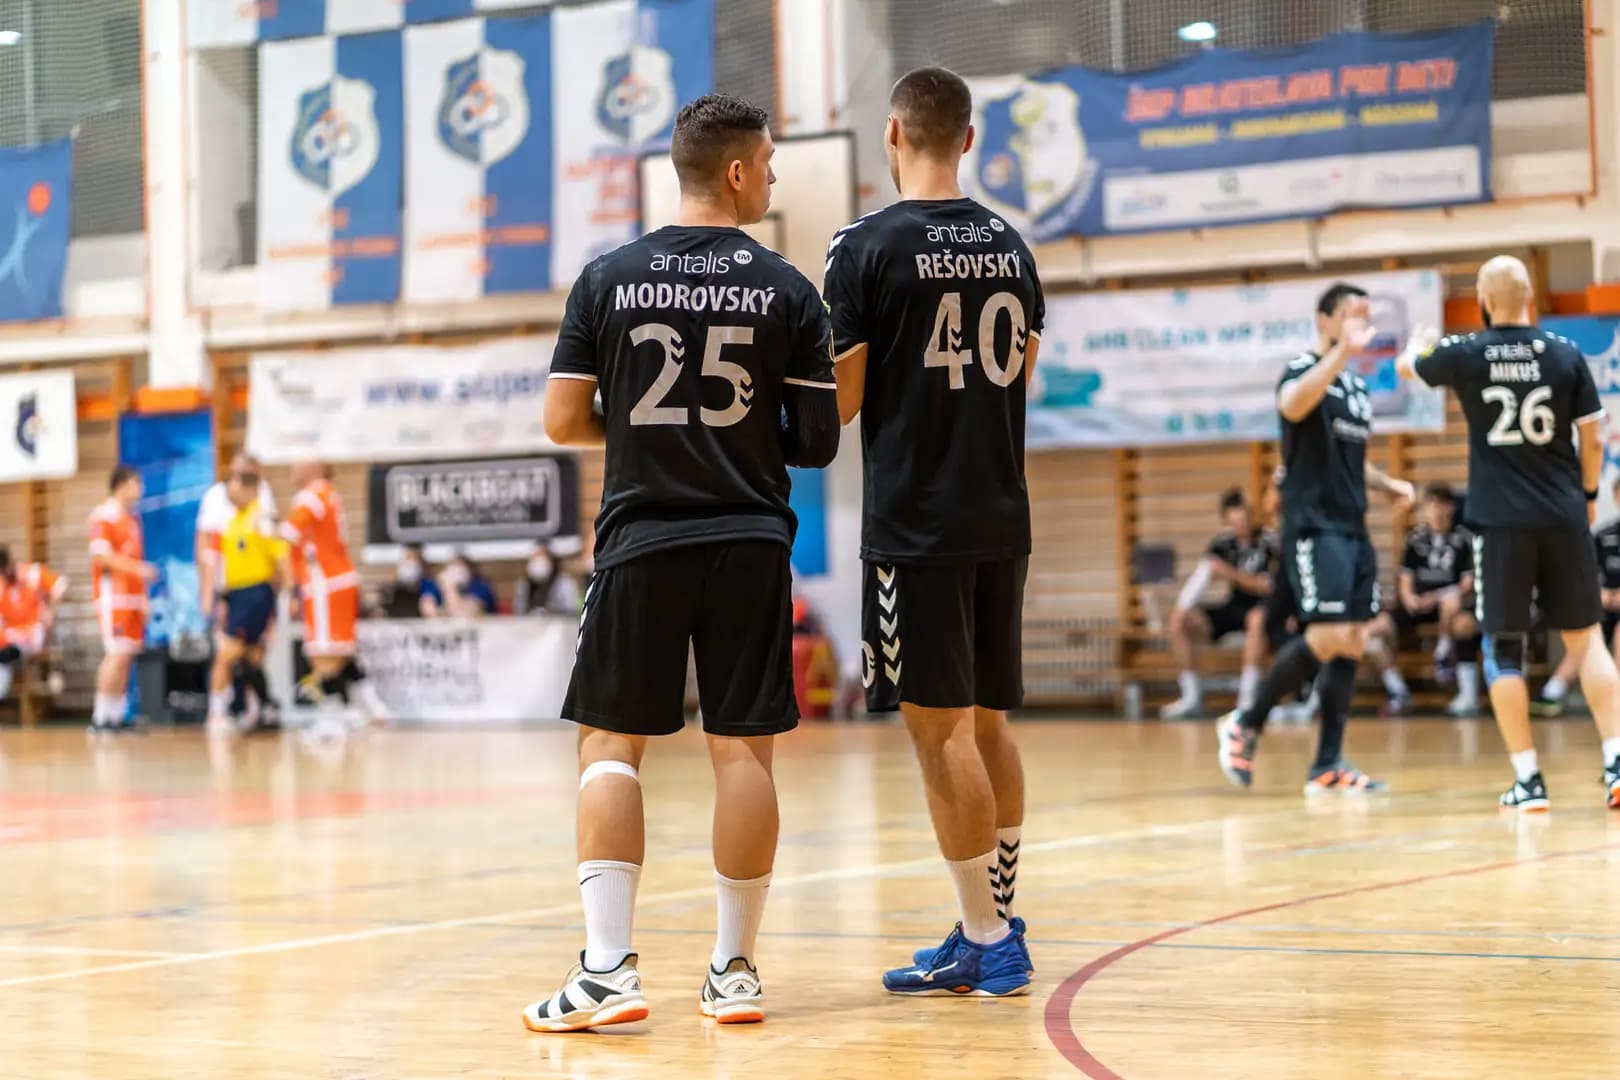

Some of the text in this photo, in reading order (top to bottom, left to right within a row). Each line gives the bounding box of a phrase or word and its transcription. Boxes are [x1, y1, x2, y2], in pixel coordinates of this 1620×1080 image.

[925, 222, 993, 243] antalis
[650, 251, 730, 274] antalis
[915, 249, 1021, 279] REŠOVSKÝ
[615, 282, 776, 315] MODROVSKÝ
[923, 291, 1026, 390] 40
[629, 322, 754, 427] 25
[1490, 359, 1541, 382] MIKUŠ
[1481, 385, 1556, 446] 26
